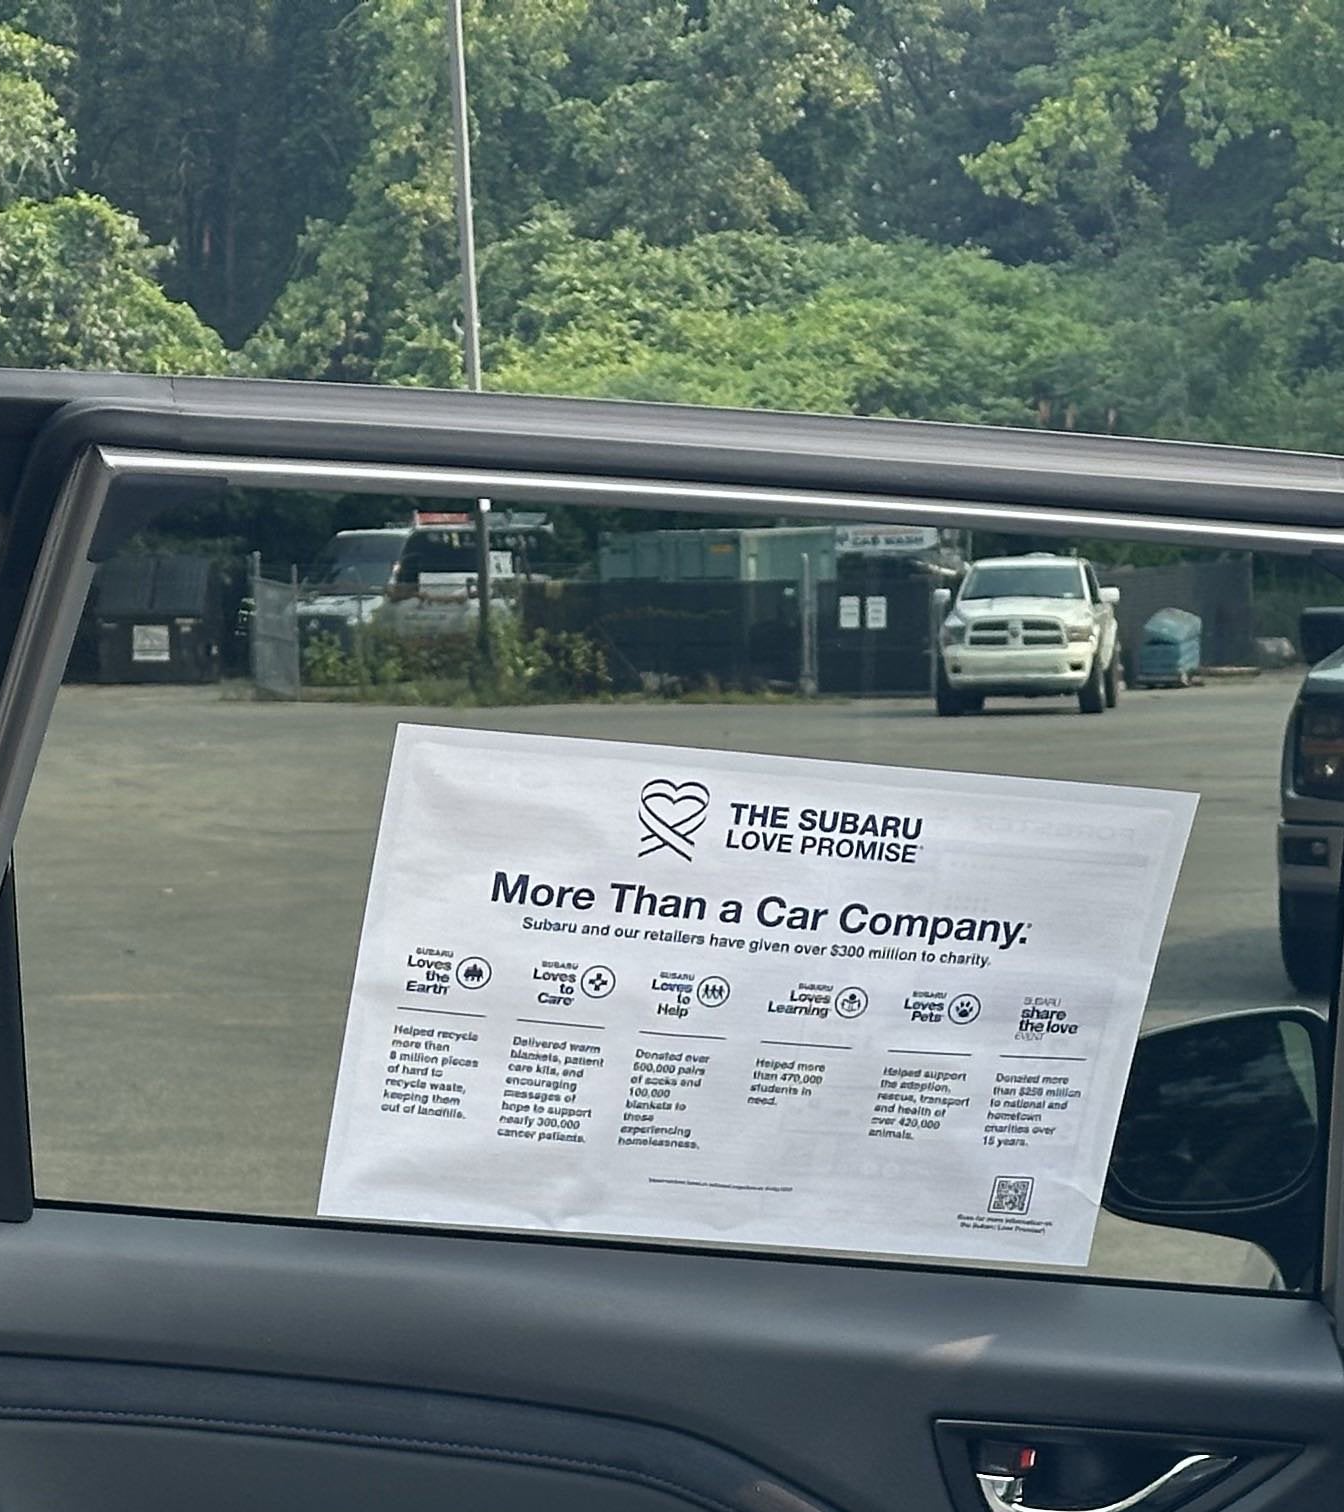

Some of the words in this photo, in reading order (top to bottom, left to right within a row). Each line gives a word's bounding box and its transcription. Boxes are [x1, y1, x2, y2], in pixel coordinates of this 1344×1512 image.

[730, 802, 790, 829] THE
[798, 808, 923, 840] SUBARU
[726, 829, 793, 853] LOVE
[800, 835, 917, 863] PROMISE
[491, 871, 595, 910] More
[610, 882, 706, 920] Than
[719, 899, 742, 924] a
[757, 896, 828, 931] Car
[522, 916, 576, 934] Subaru
[581, 923, 609, 937] and
[614, 928, 640, 939] our
[644, 929, 704, 945] retailers
[709, 934, 745, 950] have
[749, 939, 789, 953] given
[794, 944, 827, 956] over
[830, 944, 864, 958] $300
[868, 946, 917, 962] million
[921, 951, 935, 963] to
[940, 951, 991, 968] charity.
[407, 955, 452, 971] Loves
[425, 970, 450, 983] the
[533, 968, 576, 982] Loves
[406, 980, 449, 995] Earth
[559, 983, 574, 995] to
[651, 979, 693, 993] Loves
[537, 992, 574, 1006] Care
[677, 992, 690, 1005] to
[790, 990, 831, 1004] Loves
[657, 1003, 688, 1018] Help
[768, 1000, 828, 1018] Learning
[904, 999, 944, 1011] Loves
[911, 1011, 942, 1023] Pets
[1021, 1007, 1066, 1021] share
[1019, 1019, 1043, 1033] the
[1046, 1020, 1078, 1034] love
[399, 1052, 439, 1065] million
